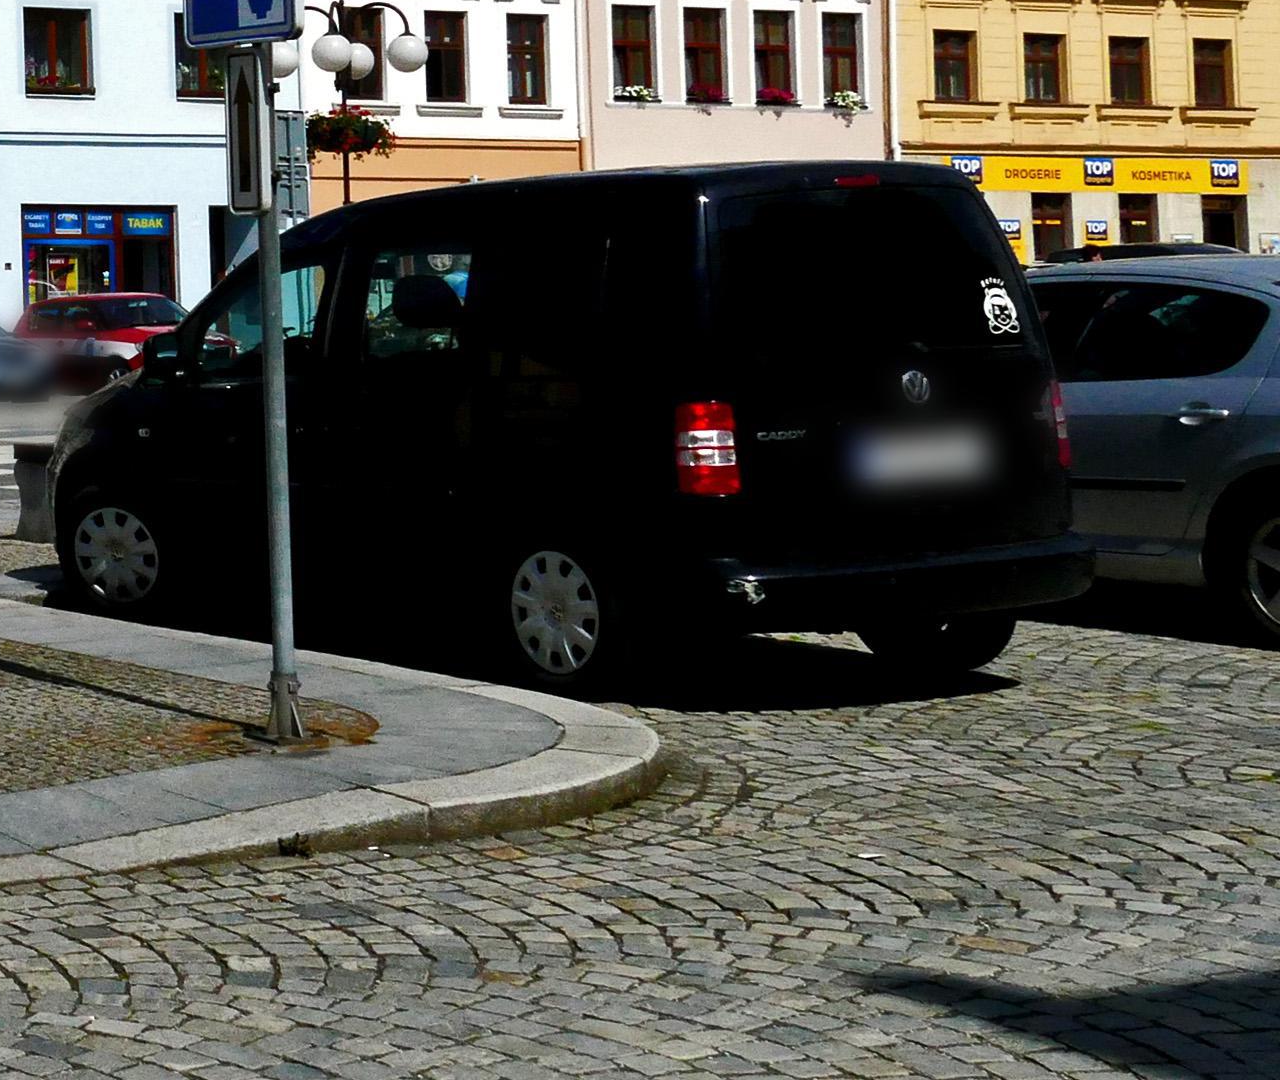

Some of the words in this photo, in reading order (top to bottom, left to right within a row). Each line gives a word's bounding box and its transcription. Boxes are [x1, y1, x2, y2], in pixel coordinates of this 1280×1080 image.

[952, 159, 981, 174] TOP
[1084, 160, 1112, 175] TOP
[1211, 163, 1238, 177] TOP
[1004, 168, 1062, 180] DROGERIE
[1131, 170, 1192, 181] KOSMETIKA
[1086, 222, 1107, 233] TOP
[756, 429, 807, 441] CADDY
